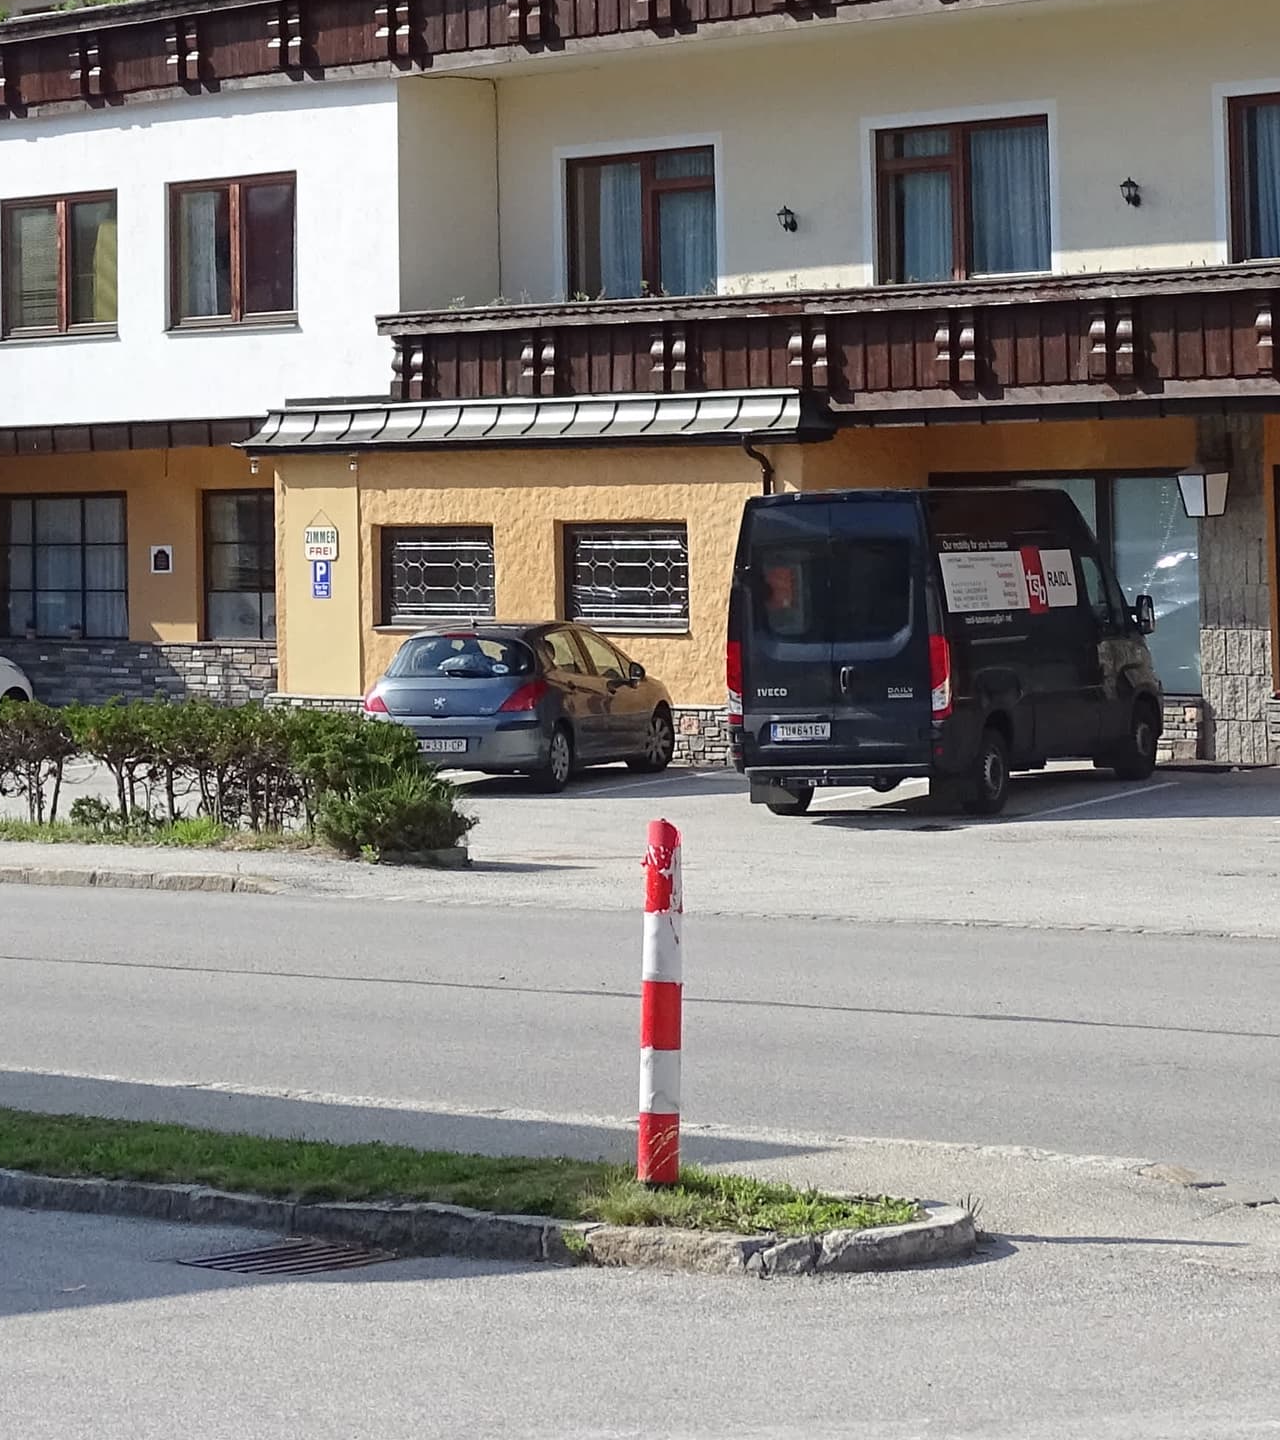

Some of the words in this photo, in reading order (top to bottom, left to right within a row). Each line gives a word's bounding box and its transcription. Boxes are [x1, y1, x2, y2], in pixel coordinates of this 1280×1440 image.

[305, 531, 336, 544] ZIMMER
[309, 547, 332, 555] FREI
[316, 562, 326, 581] P
[1047, 570, 1072, 586] RAIDL
[757, 688, 787, 696] IVECO
